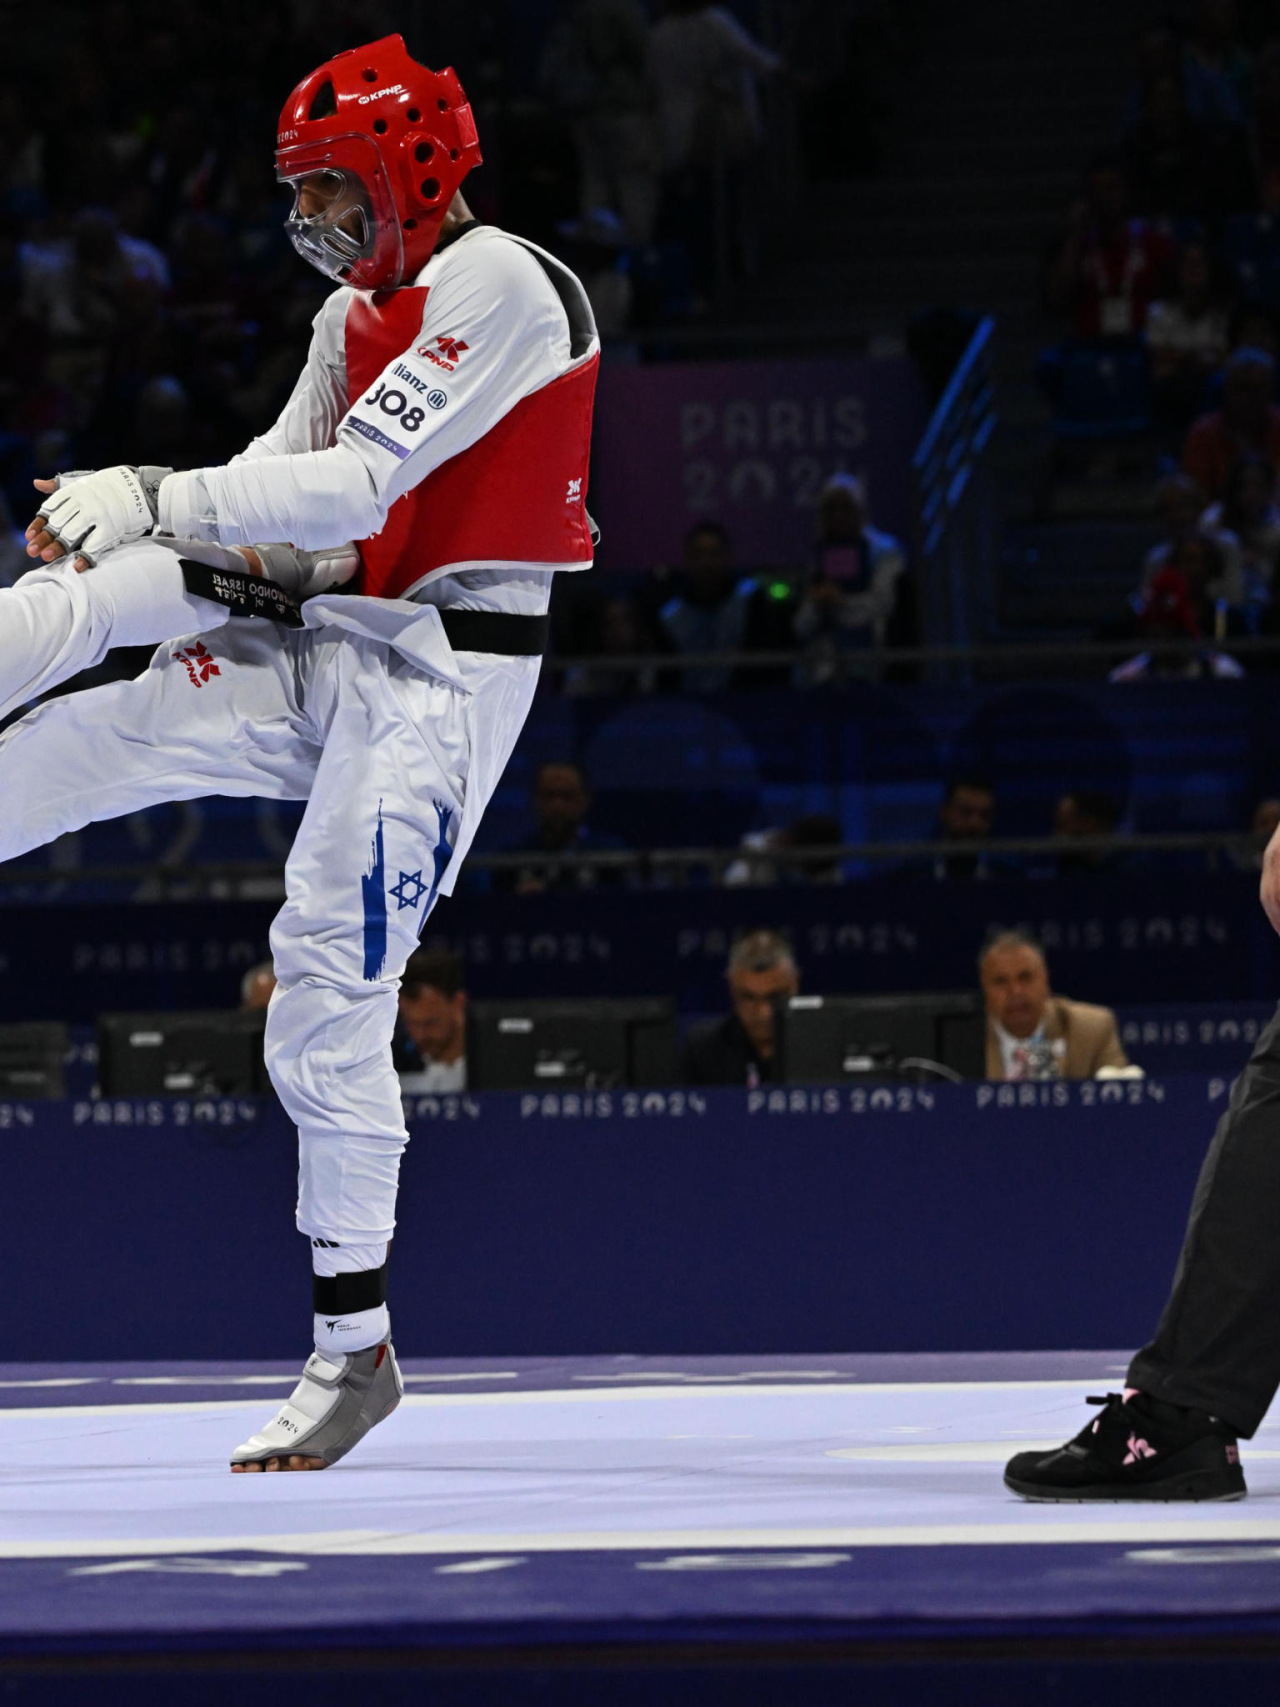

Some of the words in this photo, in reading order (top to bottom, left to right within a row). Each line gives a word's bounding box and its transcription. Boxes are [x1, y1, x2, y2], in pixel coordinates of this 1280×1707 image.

[371, 84, 402, 100] KPNP
[391, 362, 429, 395] lianz
[681, 397, 868, 452] PARIS
[1122, 1020, 1190, 1045] ARIS
[1199, 1018, 1260, 1044] 202
[521, 1093, 614, 1118] PARIS
[621, 1091, 707, 1117] 2024
[748, 1089, 841, 1115] PARIS
[849, 1087, 935, 1113] 2024
[976, 1084, 1070, 1109] PARIS
[1079, 1082, 1166, 1107] 2024
[73, 1102, 164, 1126] PARIS
[173, 1100, 257, 1125] 2024
[277, 1416, 299, 1435] 2024
